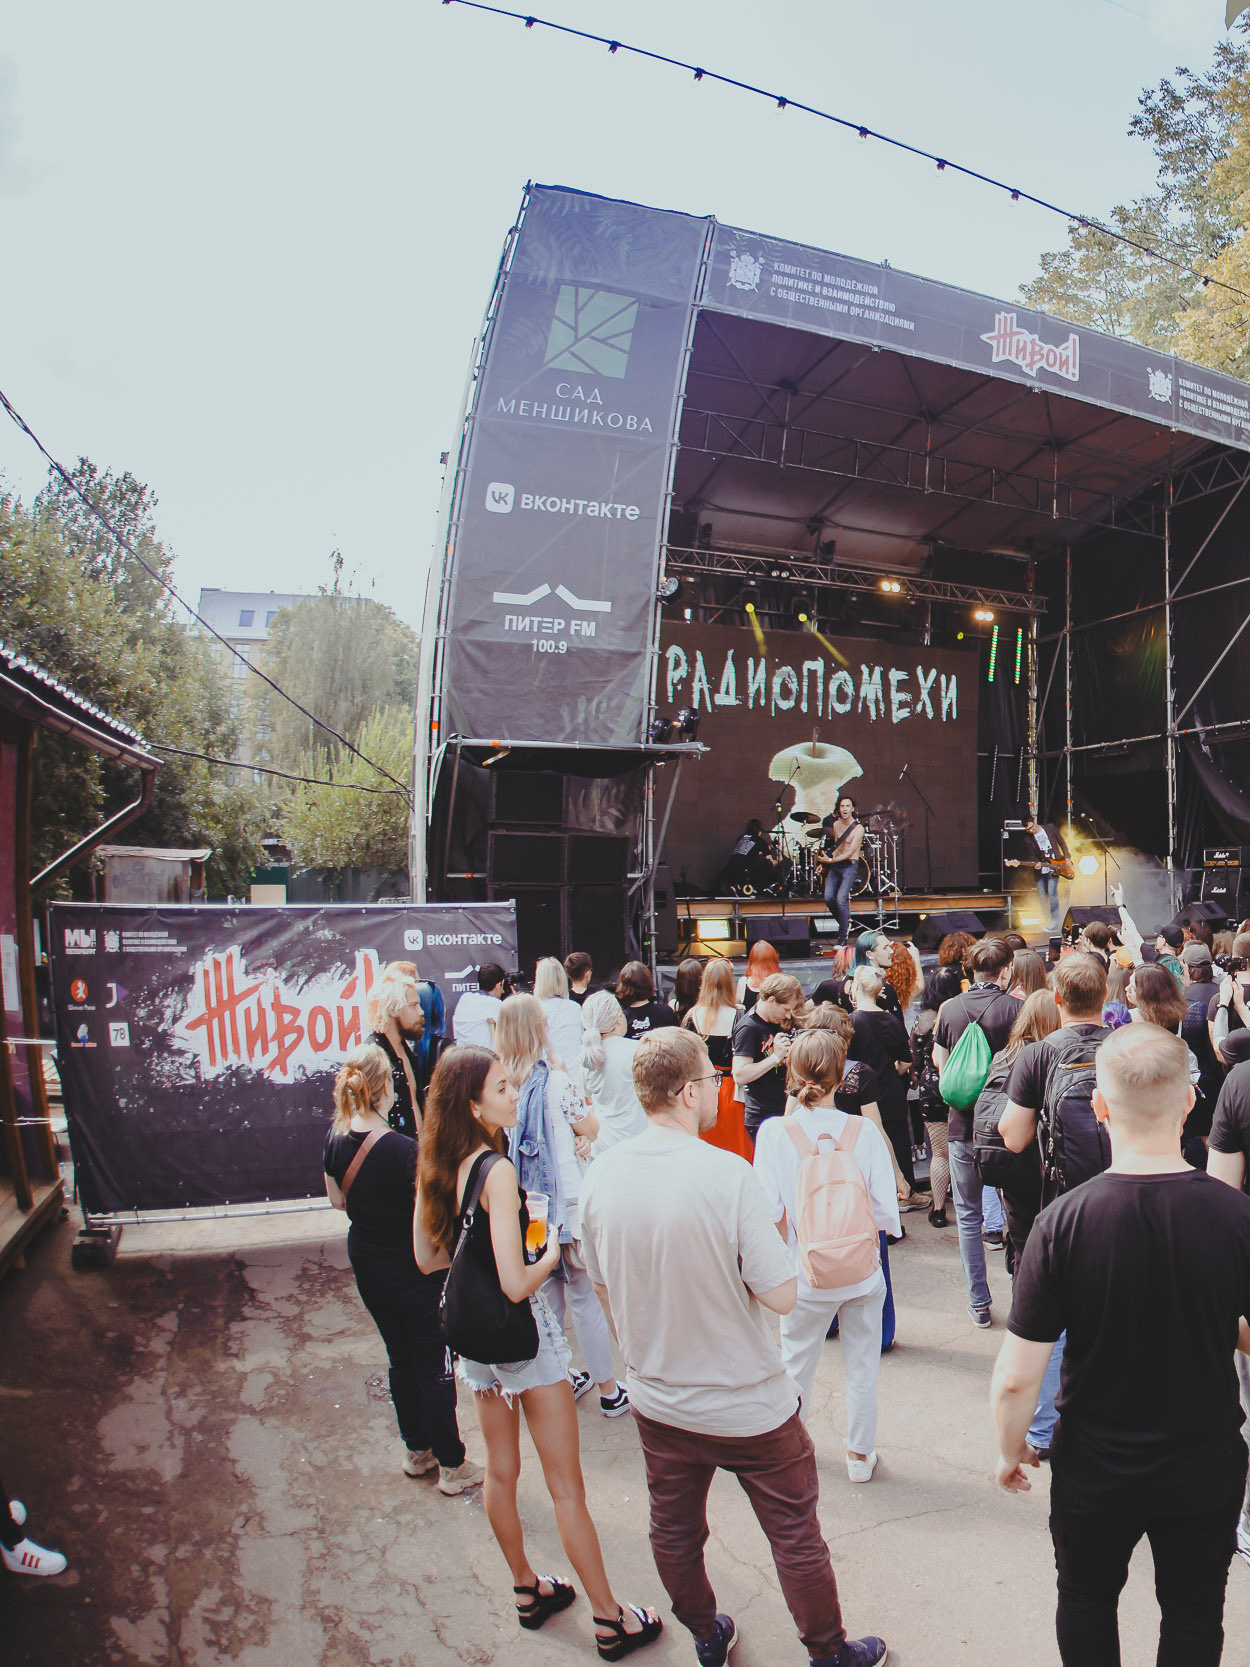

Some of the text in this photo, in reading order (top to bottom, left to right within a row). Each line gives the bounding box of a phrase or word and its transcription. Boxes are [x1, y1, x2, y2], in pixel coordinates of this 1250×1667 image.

[774, 262, 879, 295] КОМИТЕТ ПО МОЛОДЁЖНОЙ
[772, 274, 896, 312] ПОЛИТИКЕ И ВЗАИМОДЕЙСТВИЮ
[770, 287, 915, 331] С ОБЩЕСТВЕННЫМИ ОРГАНИЗАЦИЯМИ
[555, 383, 604, 406] САД
[1178, 378, 1203, 394] КОМИТЕТ
[497, 397, 654, 433] МЕНШИКОВА
[504, 614, 597, 637] ПИТЕР FM
[531, 638, 569, 654] 100.9
[665, 644, 958, 724] РАДИОПОМЕХИ
[112, 1027, 126, 1042] 78
